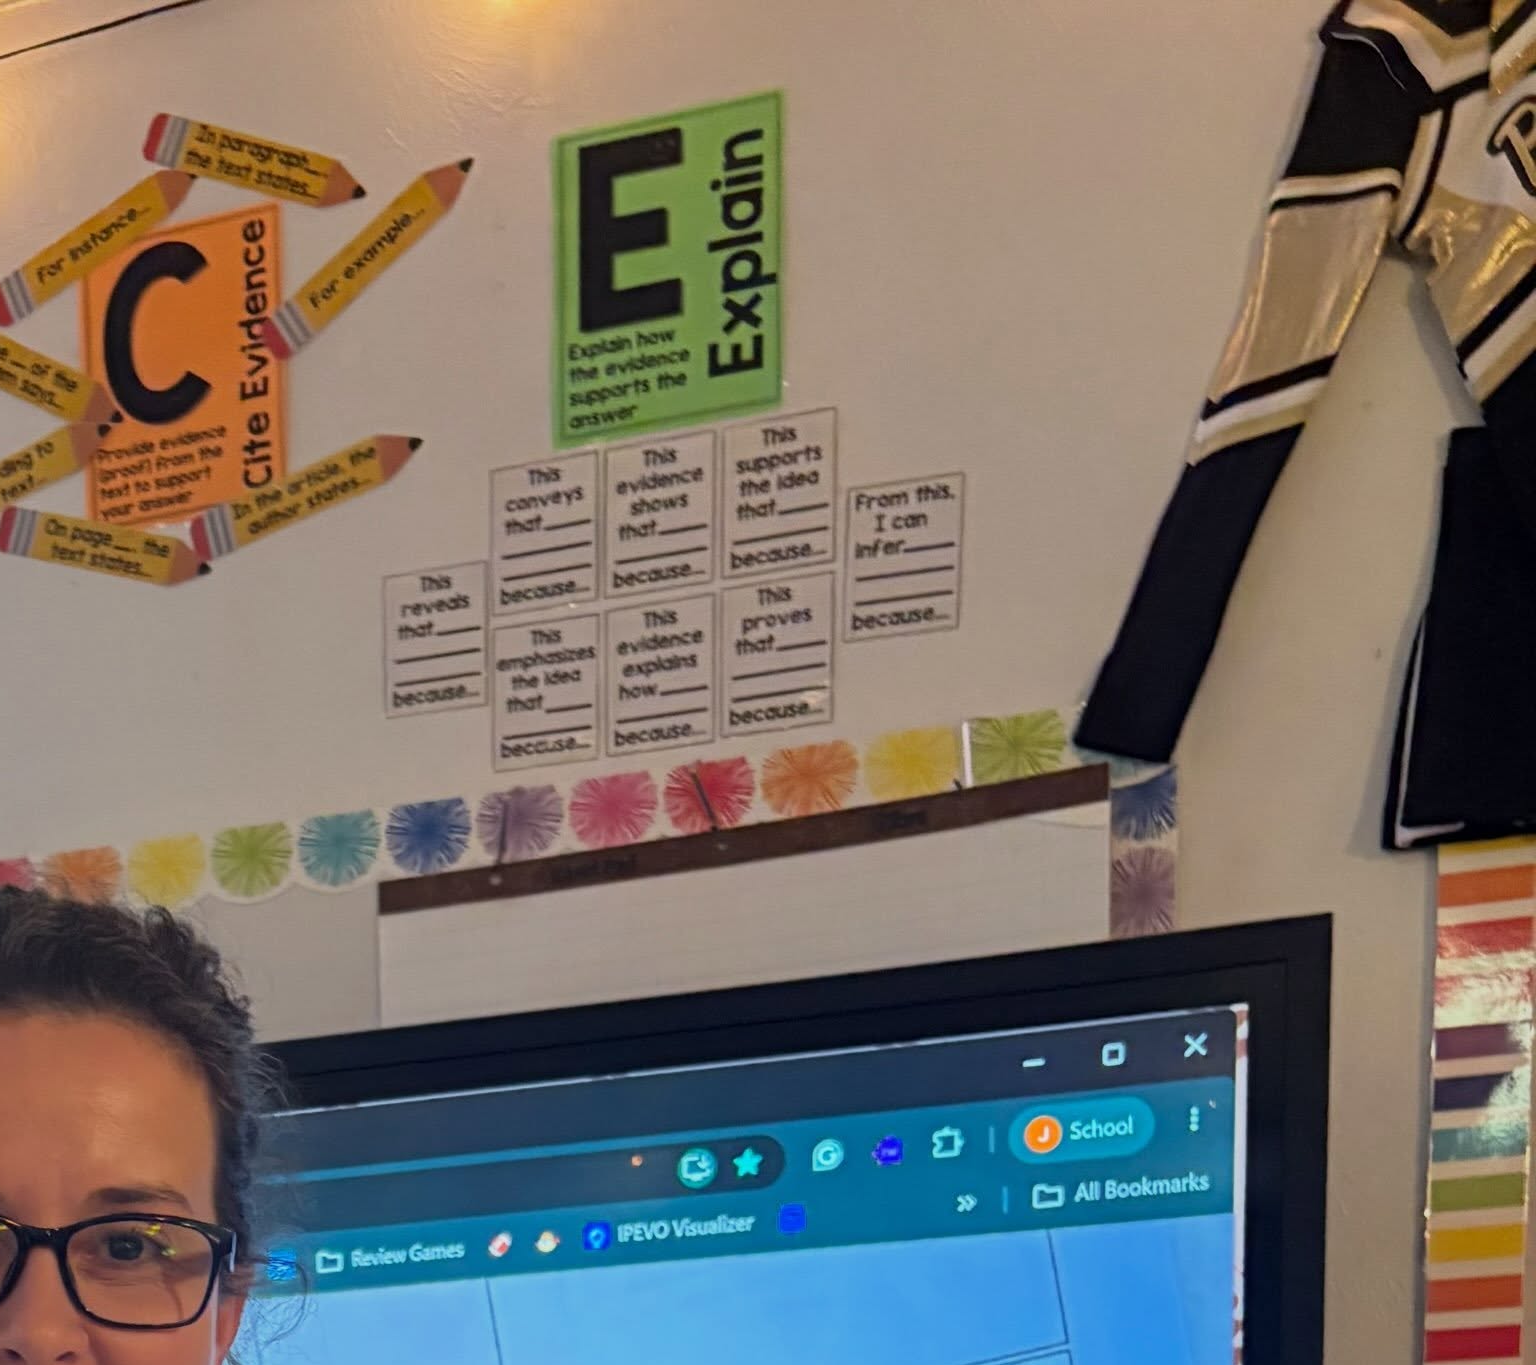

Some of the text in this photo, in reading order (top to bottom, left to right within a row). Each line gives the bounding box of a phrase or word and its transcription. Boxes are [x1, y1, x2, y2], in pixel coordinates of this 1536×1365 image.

[579, 127, 683, 334] E
[707, 128, 777, 378] Explain
[36, 257, 64, 286] For
[309, 278, 339, 311] For
[104, 240, 211, 425] C
[568, 329, 675, 361] Explain how
[239, 218, 273, 489] Cite Evidence
[570, 348, 690, 384] the evidence
[569, 372, 688, 407] supports the
[569, 404, 638, 429] answer
[761, 427, 798, 447] This
[642, 448, 678, 467] This
[735, 445, 822, 474] supports
[528, 467, 561, 486] This
[615, 467, 704, 495] evidence
[739, 470, 820, 498] the idea
[505, 486, 584, 513] conveys
[630, 493, 689, 516] shows
[855, 491, 909, 512] From
[874, 512, 929, 533] I can
[420, 575, 452, 593] This
[758, 586, 793, 606] This
[400, 594, 471, 619] reveals
[643, 610, 678, 628] This
[742, 607, 813, 635] proves
[530, 629, 562, 646] This
[616, 629, 704, 657] evidence
[623, 654, 697, 678] explains
[512, 670, 582, 691] the idea
[1038, 1114, 1135, 1143] J School
[1074, 1171, 1210, 1203] All Bookmarks
[617, 1213, 755, 1243] IPEVO Visualizer
[351, 1239, 465, 1269] Review Games
